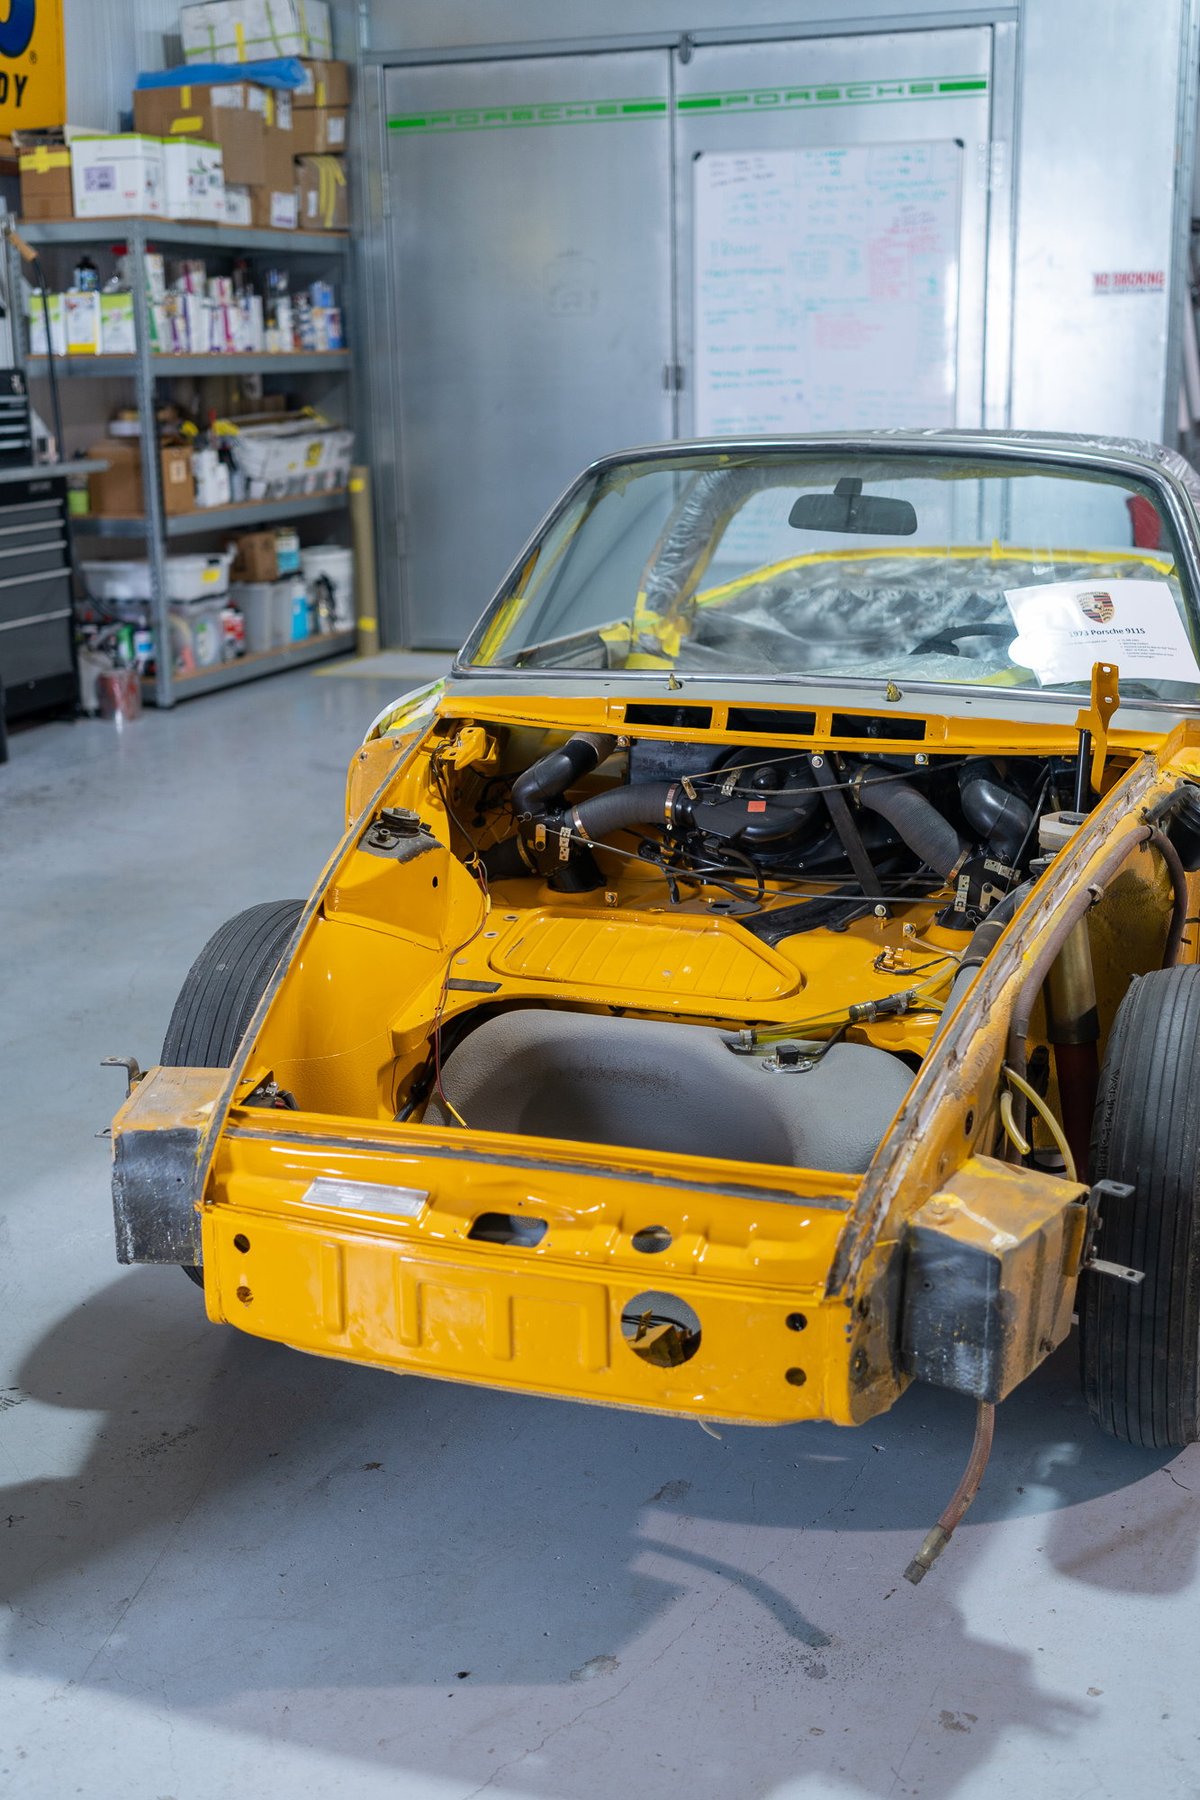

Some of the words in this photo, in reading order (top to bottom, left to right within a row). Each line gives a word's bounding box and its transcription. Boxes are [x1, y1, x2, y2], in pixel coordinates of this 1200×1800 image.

[725, 83, 934, 107] PORSCHE
[430, 105, 618, 128] PORSCHE
[1090, 628, 1124, 636] Porsche
